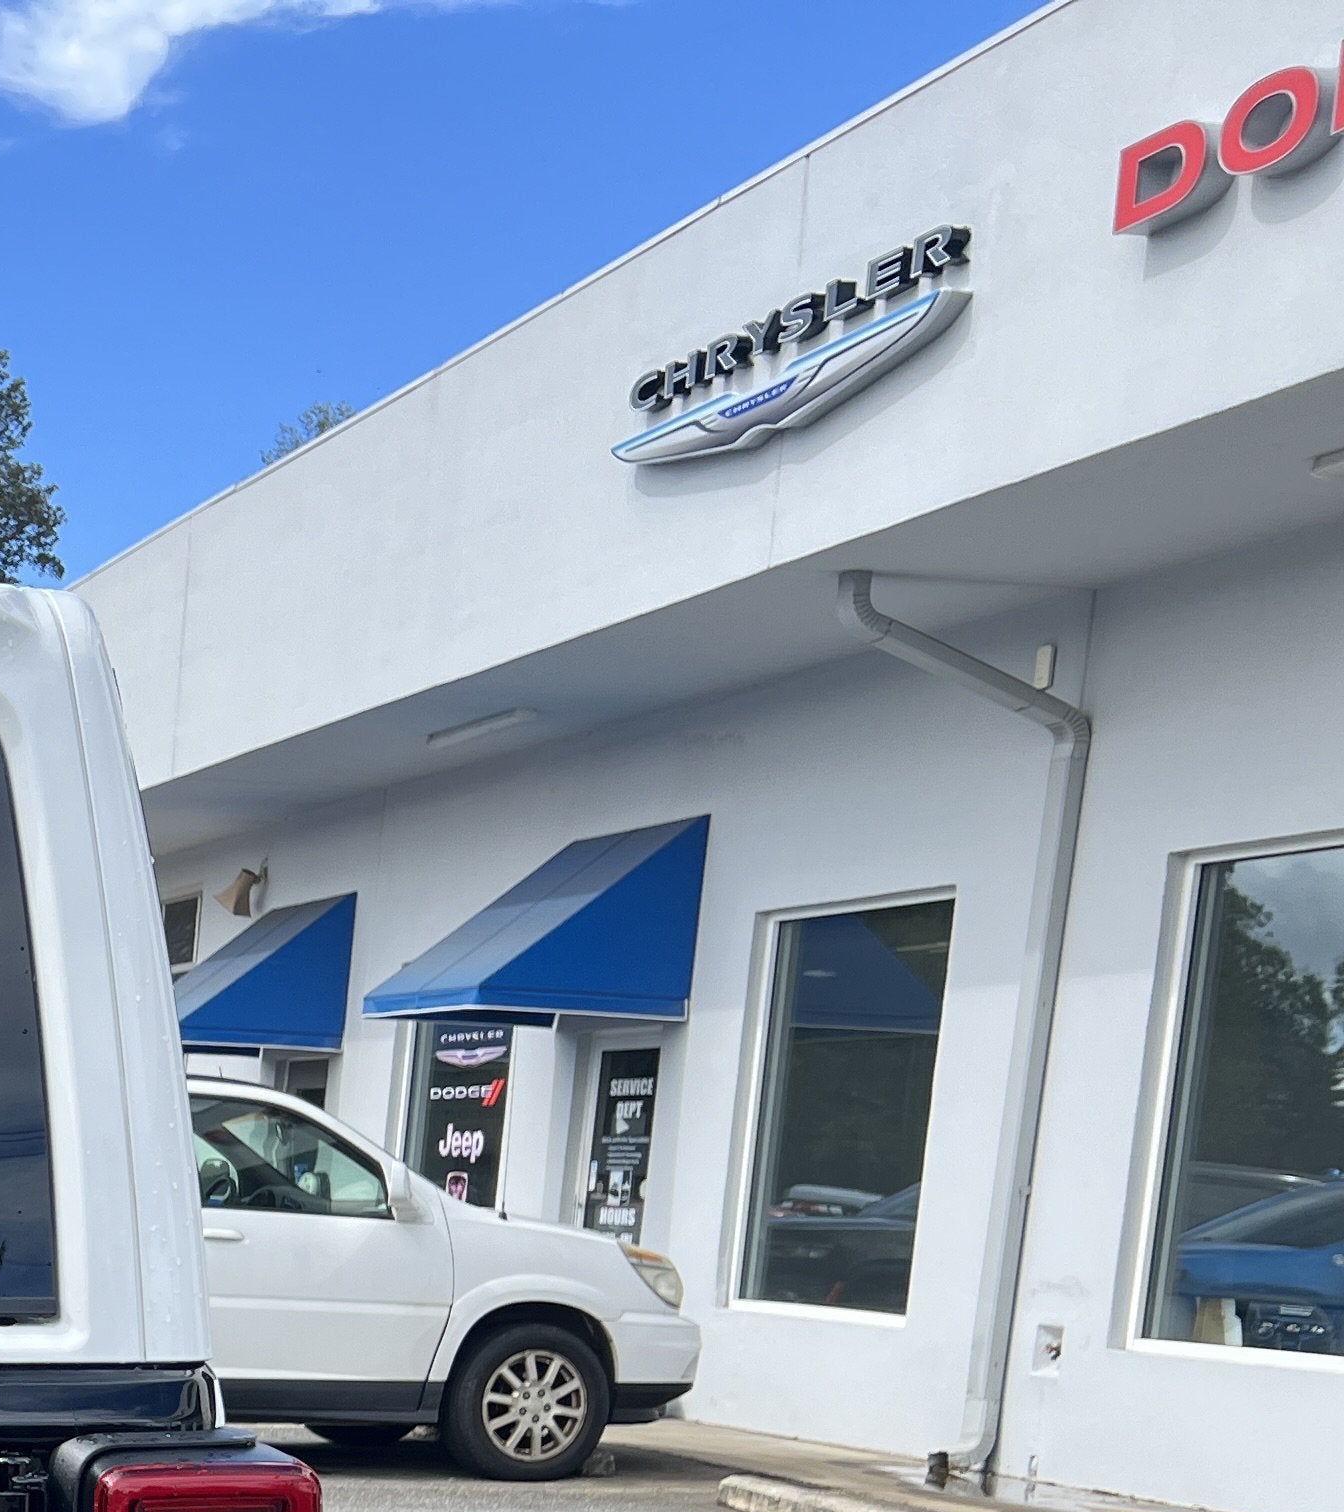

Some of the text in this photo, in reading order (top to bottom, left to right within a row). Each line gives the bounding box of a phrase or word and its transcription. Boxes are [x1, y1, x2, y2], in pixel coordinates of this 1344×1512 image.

[1112, 38, 1344, 235] DO
[629, 224, 971, 411] CHRYSLER
[429, 1083, 495, 1101] DODGE
[609, 1077, 654, 1097] SERVICE
[615, 1101, 644, 1120] DEPT
[438, 1122, 485, 1164] Jeep
[598, 1206, 637, 1226] HOURS
